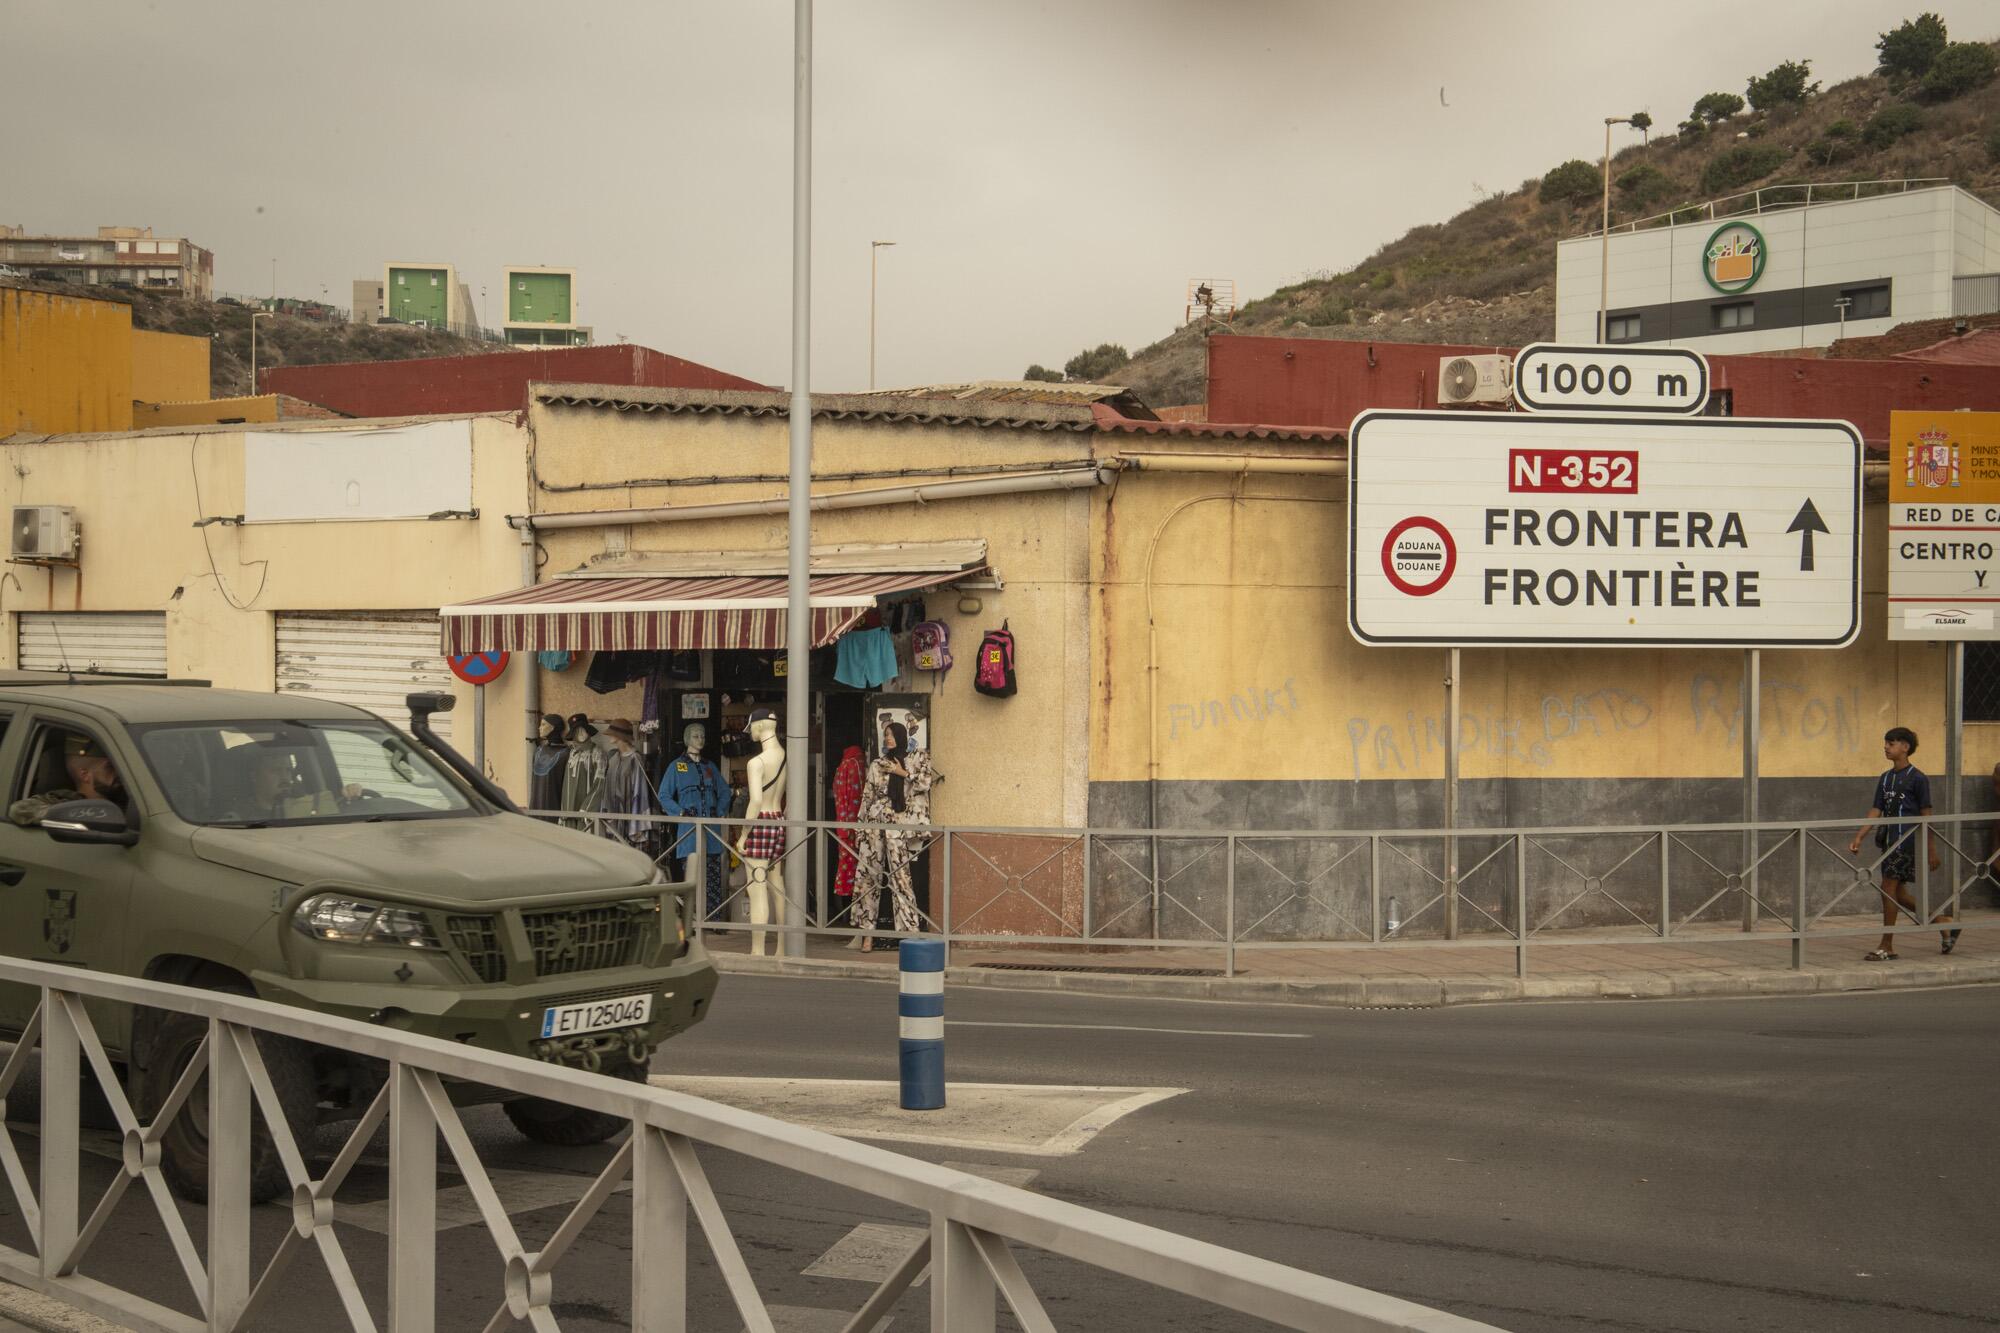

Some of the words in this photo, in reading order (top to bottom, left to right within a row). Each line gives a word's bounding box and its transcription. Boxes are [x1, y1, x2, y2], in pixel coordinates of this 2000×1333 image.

[1536, 363, 1632, 396] 1000
[1657, 374, 1688, 397] m
[1514, 455, 1632, 488] N-352
[1987, 458, 2000, 467] TR
[1906, 508, 1942, 522] RED
[1952, 508, 1975, 522] DE
[1985, 508, 2000, 522] C
[1485, 508, 1748, 548] FRONTERA
[1397, 541, 1441, 551] ADUANA
[1900, 542, 1993, 560] CENTRO
[1397, 562, 1441, 571] DOUANE
[1484, 561, 1761, 608] FRONTIÈRE
[1974, 570, 1987, 588] Y
